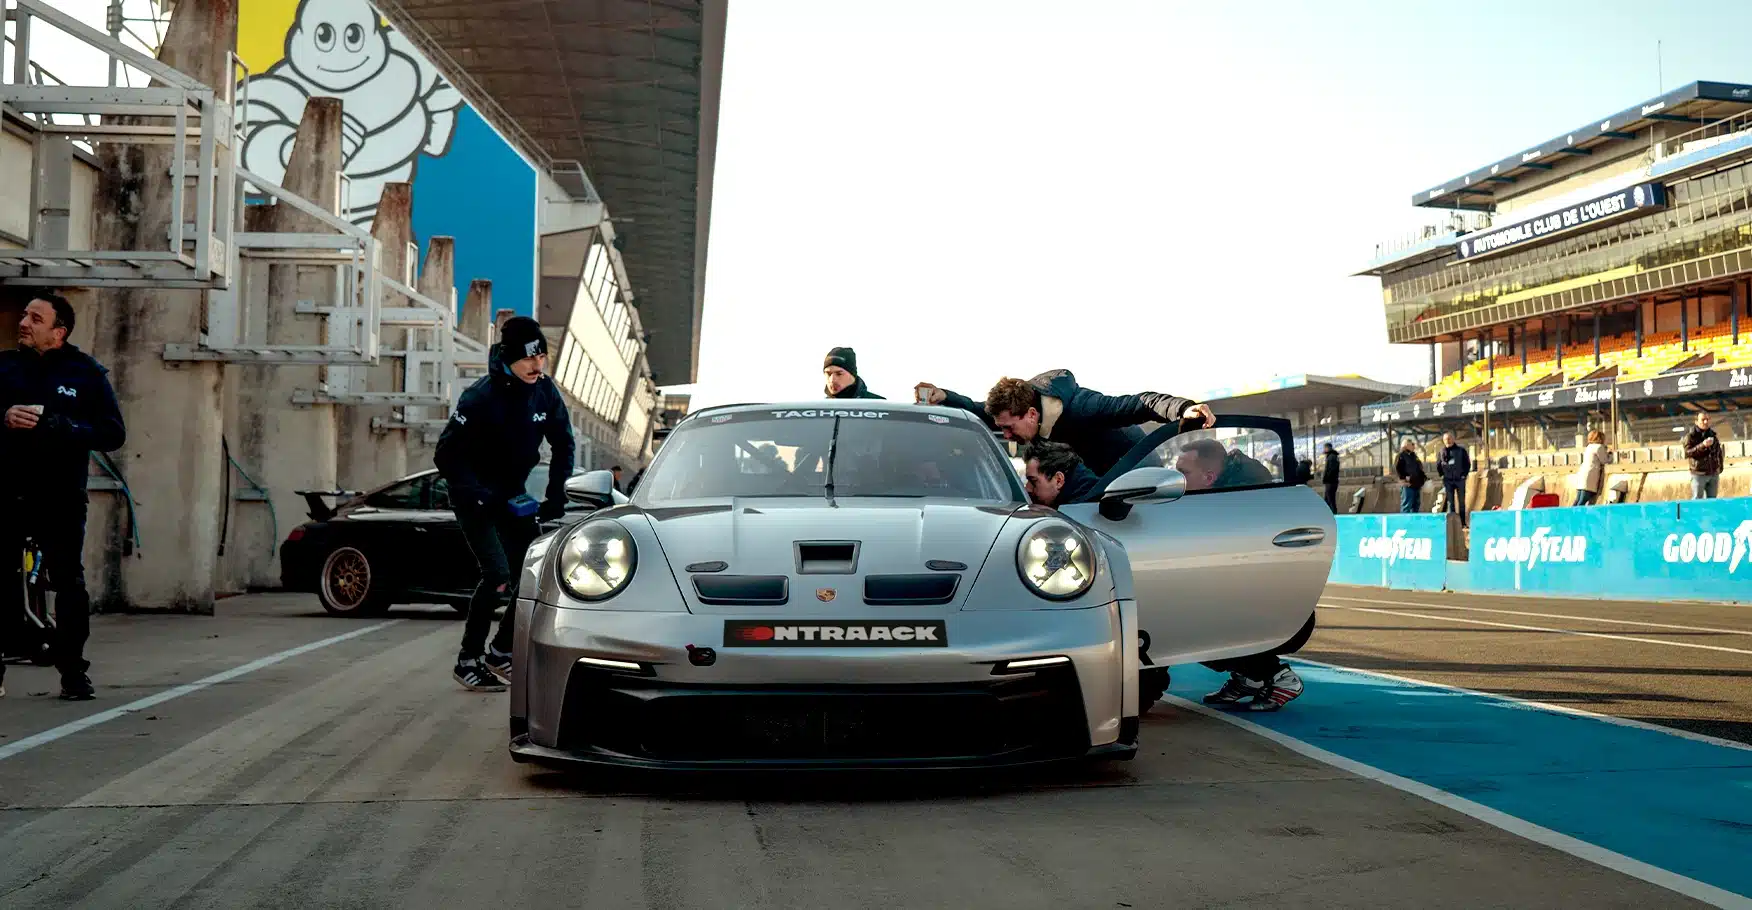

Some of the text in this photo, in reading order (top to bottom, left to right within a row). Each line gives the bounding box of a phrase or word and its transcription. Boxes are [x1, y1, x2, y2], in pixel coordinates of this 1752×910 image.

[1473, 193, 1627, 253] AUTOMOBILE CLUB DE L'OUEST
[1358, 530, 1433, 566] GOODYEAR
[1484, 528, 1587, 570] GOODYEAR
